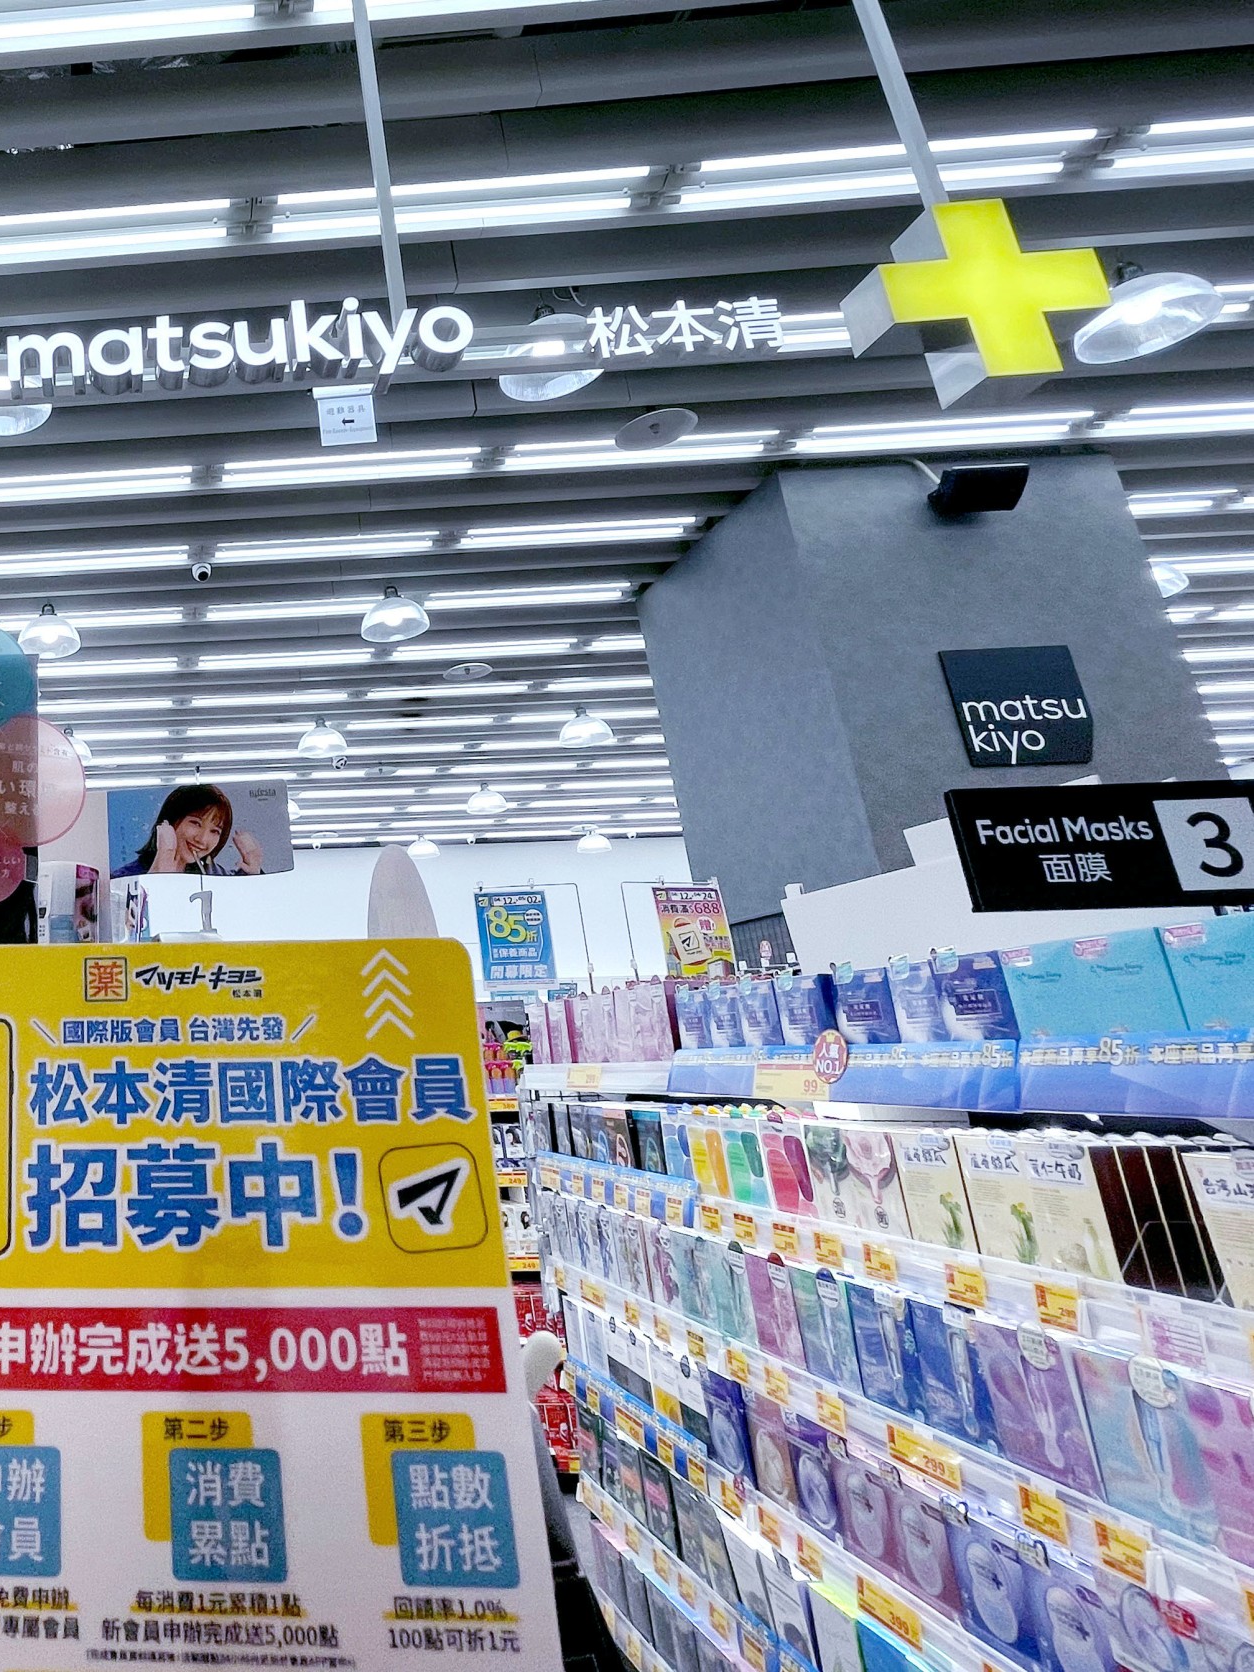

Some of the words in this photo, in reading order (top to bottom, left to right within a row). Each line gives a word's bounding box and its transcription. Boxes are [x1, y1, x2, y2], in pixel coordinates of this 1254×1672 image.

[6, 298, 474, 376] matsukiyo
[586, 297, 784, 358] 松本清
[962, 695, 1088, 722] matsu
[969, 724, 1046, 765] kiyo
[976, 818, 1059, 844] Facial
[1067, 815, 1154, 842] Masks
[1187, 811, 1244, 877] 3
[1039, 852, 1113, 883] 面膜
[87, 959, 126, 999] 薬
[63, 1017, 181, 1044] 國際版會員
[189, 1016, 286, 1042] 台灣先發
[815, 1059, 841, 1074] NO.1
[819, 1043, 839, 1059] 人氣
[29, 1056, 476, 1126] 松本清國際會員
[26, 1141, 364, 1250] 招募中！
[163, 1416, 230, 1441] 第二步
[383, 1418, 451, 1444] 第三步
[185, 1461, 266, 1507] 消費
[408, 1463, 495, 1512] 點數
[189, 1518, 271, 1567] 累點
[415, 1522, 503, 1573] 折抵
[136, 1589, 302, 1617] 每消費1元累積1點
[102, 1618, 339, 1649] 新會員申辦完成送5,000點
[389, 1627, 521, 1652] 100點可折1元
